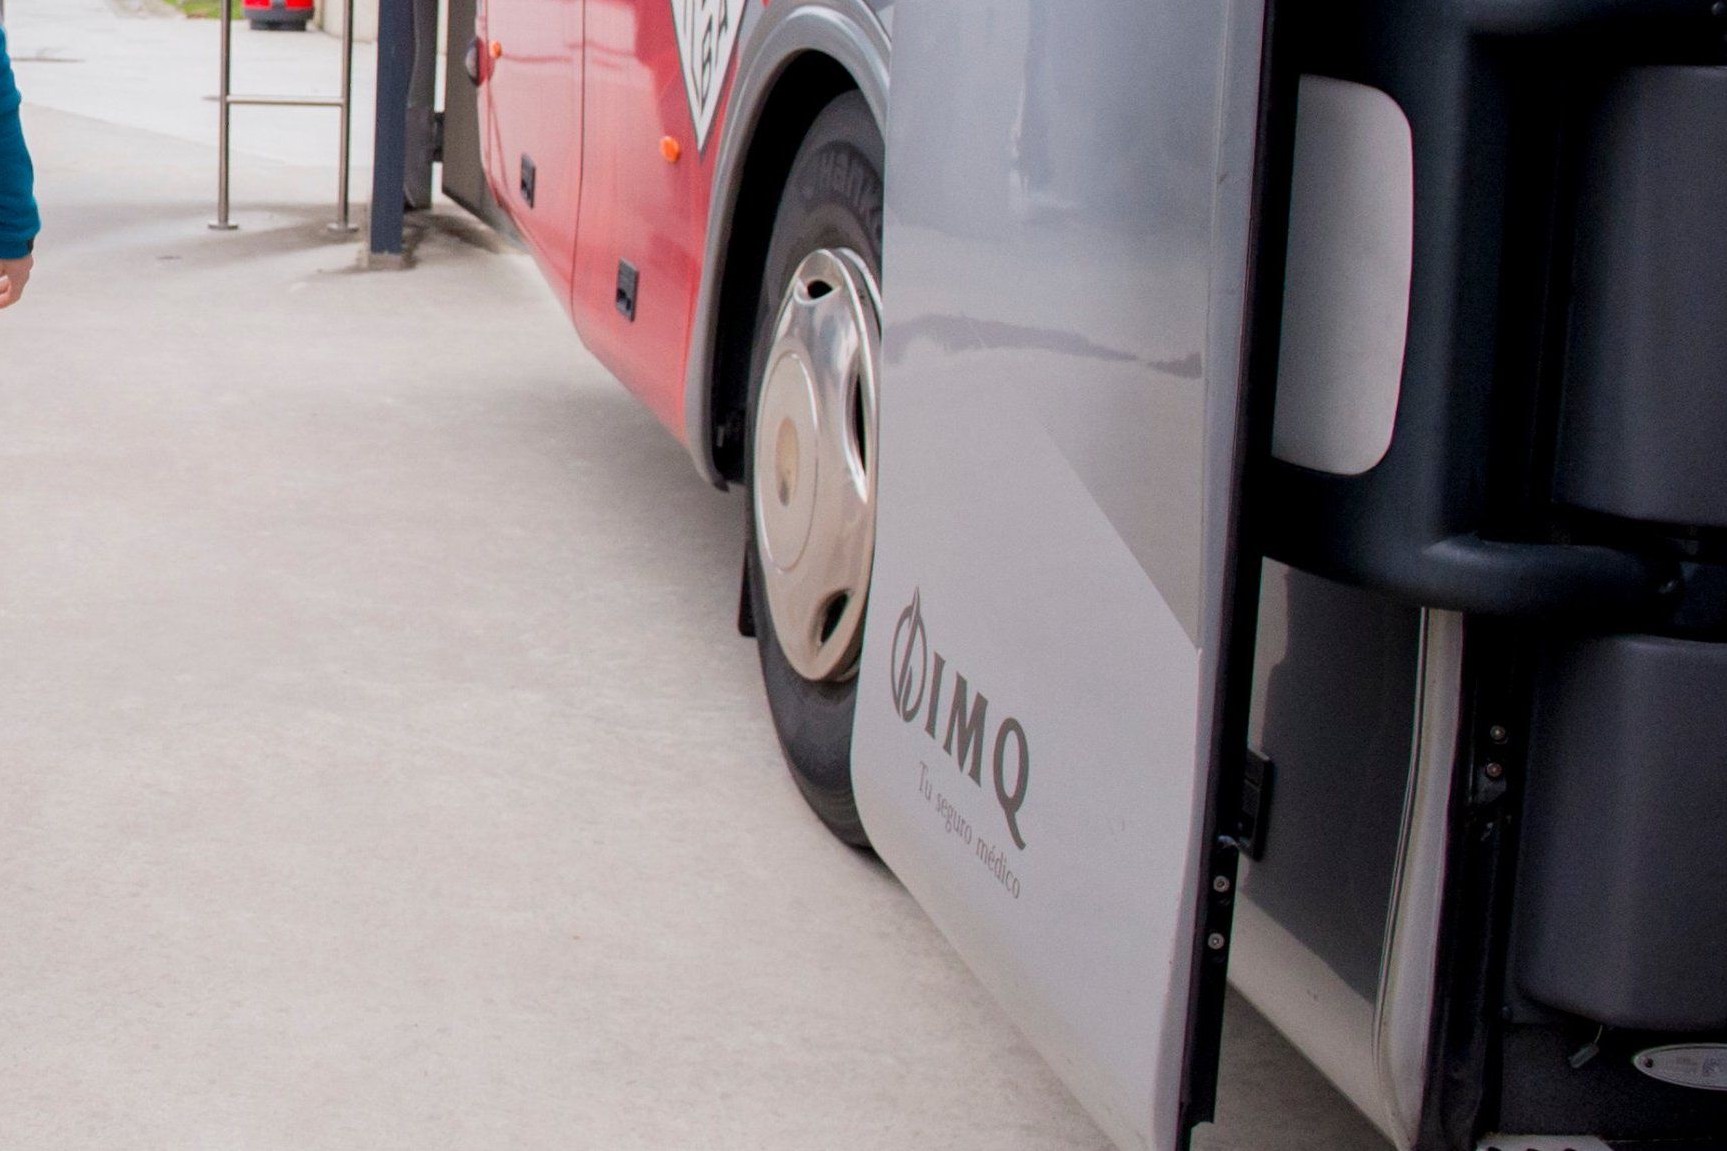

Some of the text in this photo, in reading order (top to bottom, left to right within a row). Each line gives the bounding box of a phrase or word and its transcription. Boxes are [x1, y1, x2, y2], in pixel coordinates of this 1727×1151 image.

[918, 761, 1021, 899] Tu seguro médico
[926, 651, 1030, 850] IMQ
